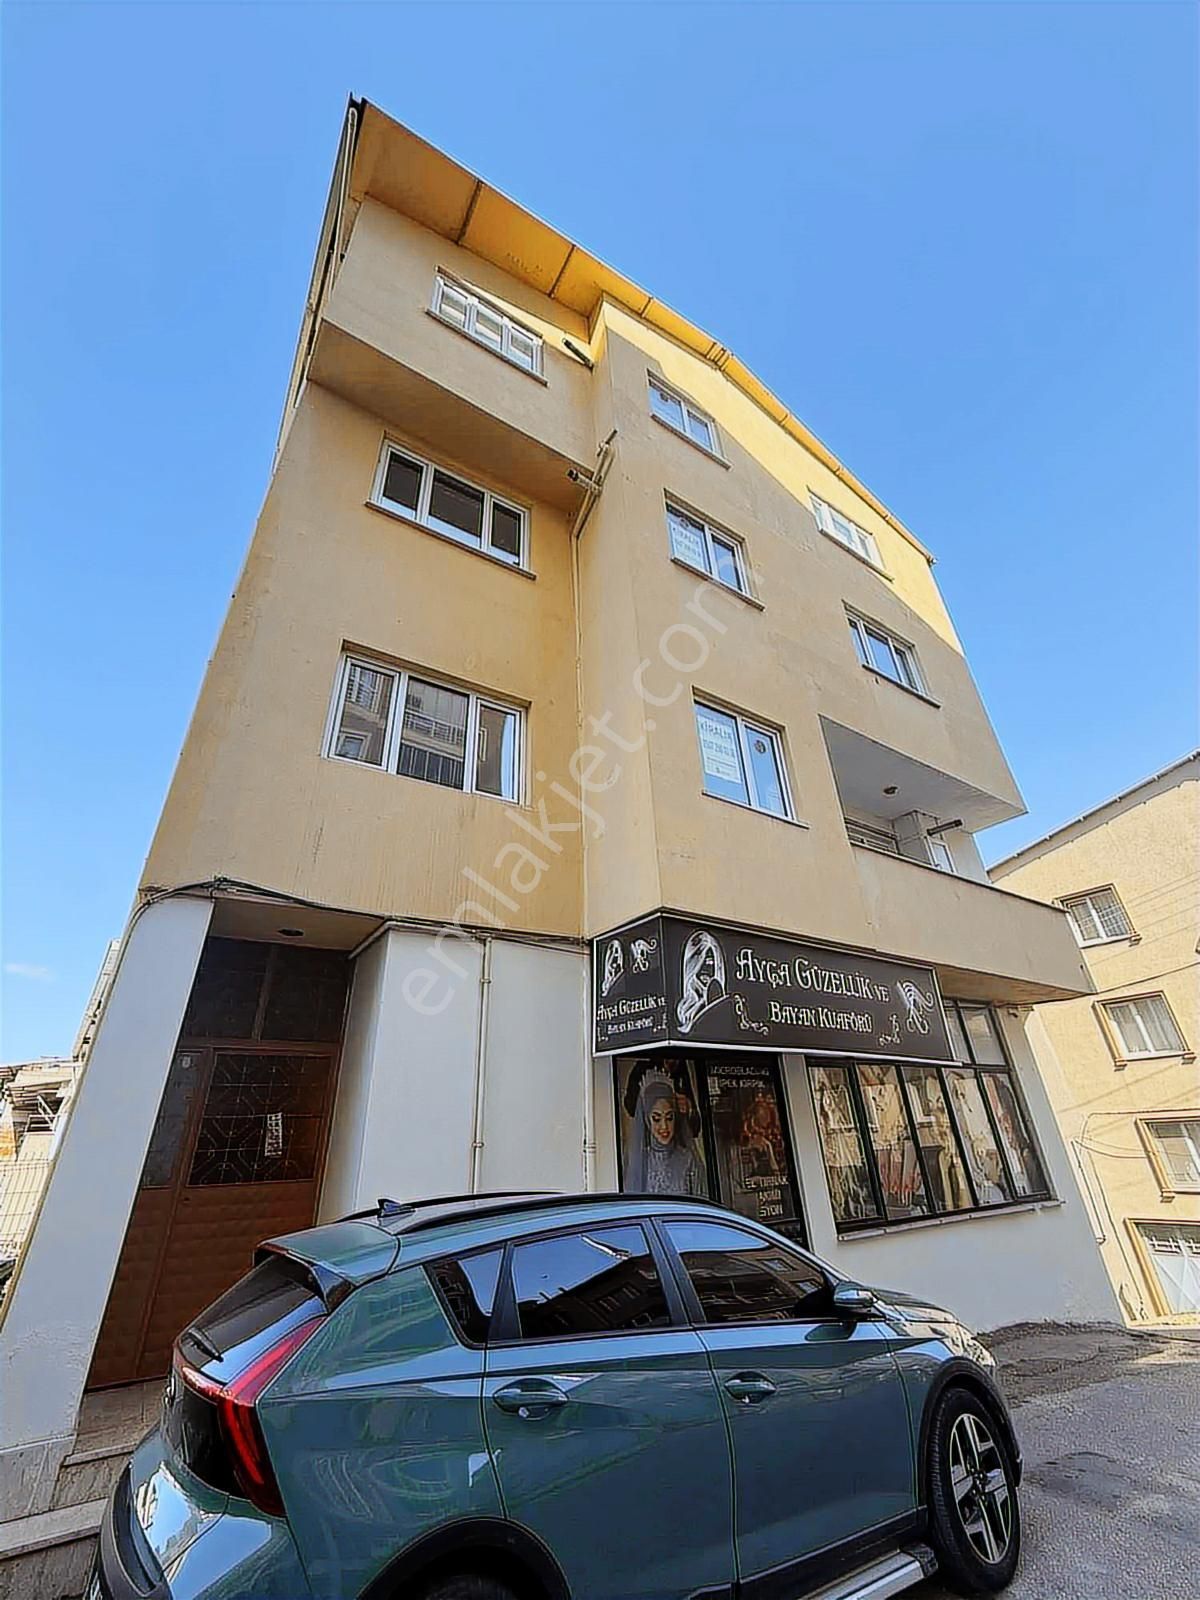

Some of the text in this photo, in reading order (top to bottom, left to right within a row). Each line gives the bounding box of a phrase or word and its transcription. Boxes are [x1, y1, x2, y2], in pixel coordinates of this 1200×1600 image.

[736, 949, 792, 988] AYÇA
[795, 958, 874, 1000] GÜZELLİK
[769, 1001, 817, 1027] BAYAN
